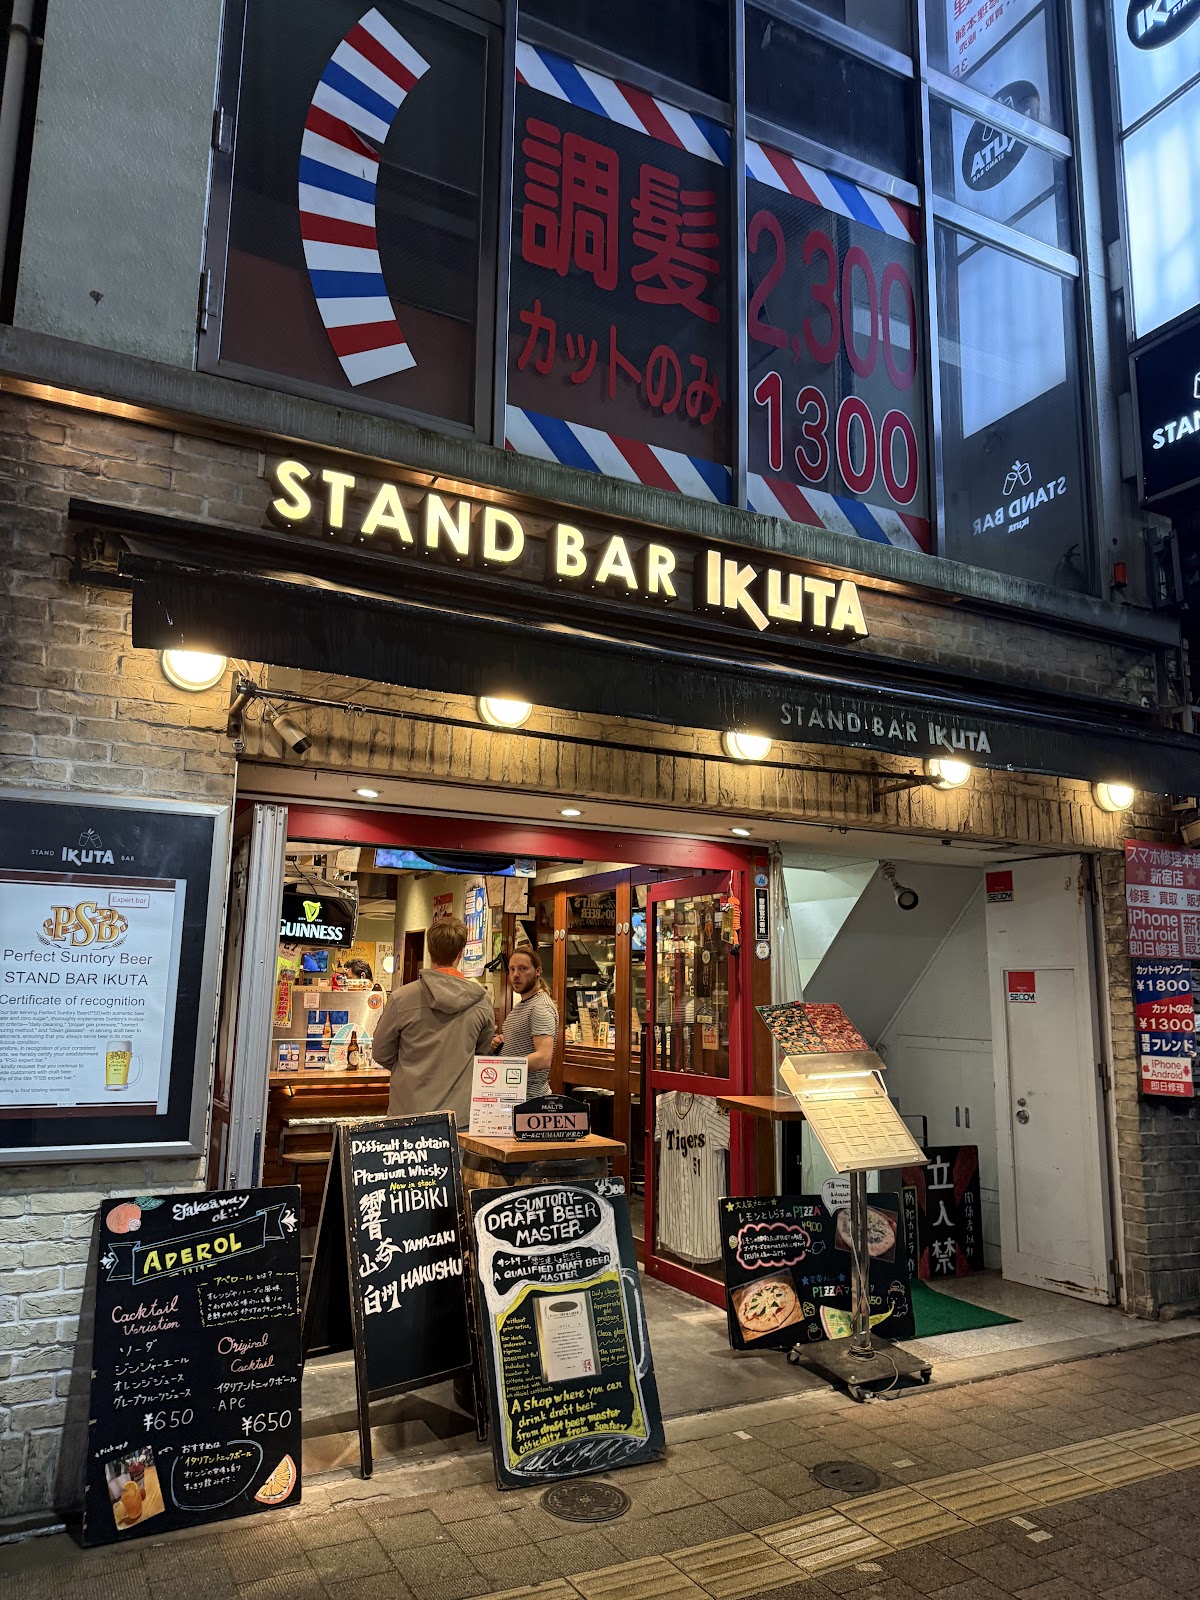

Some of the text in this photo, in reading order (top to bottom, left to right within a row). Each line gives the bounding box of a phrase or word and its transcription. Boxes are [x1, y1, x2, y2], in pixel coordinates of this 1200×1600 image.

[521, 117, 720, 324] 調髪
[748, 210, 918, 391] 2,300
[517, 299, 722, 426] カットのみ
[754, 370, 919, 506] 1300
[272, 461, 871, 638] STAND BAR IKUTA
[780, 702, 992, 754] STAND BAR IKUTA
[61, 846, 115, 867] IKUTA
[1127, 846, 1200, 869] スマホ修理本舗
[1151, 868, 1184, 886] 新宿店
[112, 895, 147, 905] Expert bar
[988, 892, 1013, 901] SECOM
[51, 900, 121, 946] PSB
[1128, 909, 1179, 927] iPhone
[1129, 926, 1179, 942] Android
[3, 950, 153, 967] Perfect Suntory Beer
[1130, 941, 1180, 957] 即日修理
[4, 971, 149, 986] STAND BAR IKUTA
[1137, 980, 1190, 992] ¥1800
[0, 994, 146, 1008] Certificate of recognition
[1010, 993, 1035, 1001] SECOM
[1152, 1004, 1194, 1014] カットのみ
[1139, 1018, 1193, 1031] ¥1300
[1152, 1039, 1193, 1052] フレンド
[1151, 1059, 1182, 1070] iPhone
[1151, 1070, 1183, 1080] Android
[1151, 1081, 1185, 1093] 即日修理
[527, 1115, 577, 1130] OPEN
[352, 1136, 450, 1155] Difficult to obtain
[666, 1128, 705, 1158] Tigers
[383, 1149, 428, 1166] JAPAN
[354, 1163, 449, 1187] Premium Whisky
[390, 1178, 437, 1191] Now in stock
[172, 1195, 250, 1221] Takeaway
[390, 1186, 449, 1214] HIBIKI
[514, 1192, 575, 1213] SUNTORY
[487, 1202, 598, 1231] DRAFT BEER
[801, 1220, 822, 1232] ¥900
[402, 1229, 456, 1254] YAMAZAKI
[515, 1220, 585, 1247] MASTER
[905, 1191, 916, 1280] 防犯カメラ作
[143, 1232, 242, 1275] APEROL
[401, 1257, 463, 1293] HAKUSHU
[493, 1271, 501, 1282] A
[504, 1265, 553, 1279] QUALIFIED
[556, 1260, 583, 1272] DRAFT
[585, 1255, 611, 1268] BEER
[539, 1270, 578, 1282] MASTER
[363, 1280, 402, 1316] 白州
[120, 1339, 158, 1356] ソーダ
[217, 1332, 269, 1355] Original
[115, 1357, 189, 1376] ジンジャーエール
[113, 1374, 185, 1392] オレンジジュース
[113, 1388, 192, 1410] グレープフルーツジュース
[511, 1380, 623, 1415] A shop where you can
[143, 1408, 194, 1432] ¥650
[241, 1409, 292, 1436] ¥650
[518, 1401, 597, 1428] drink draft beer
[516, 1408, 622, 1443] from draft beer master
[566, 1425, 589, 1438] from
[594, 1419, 628, 1431] Suntory
[181, 1441, 221, 1454] おすすめは
